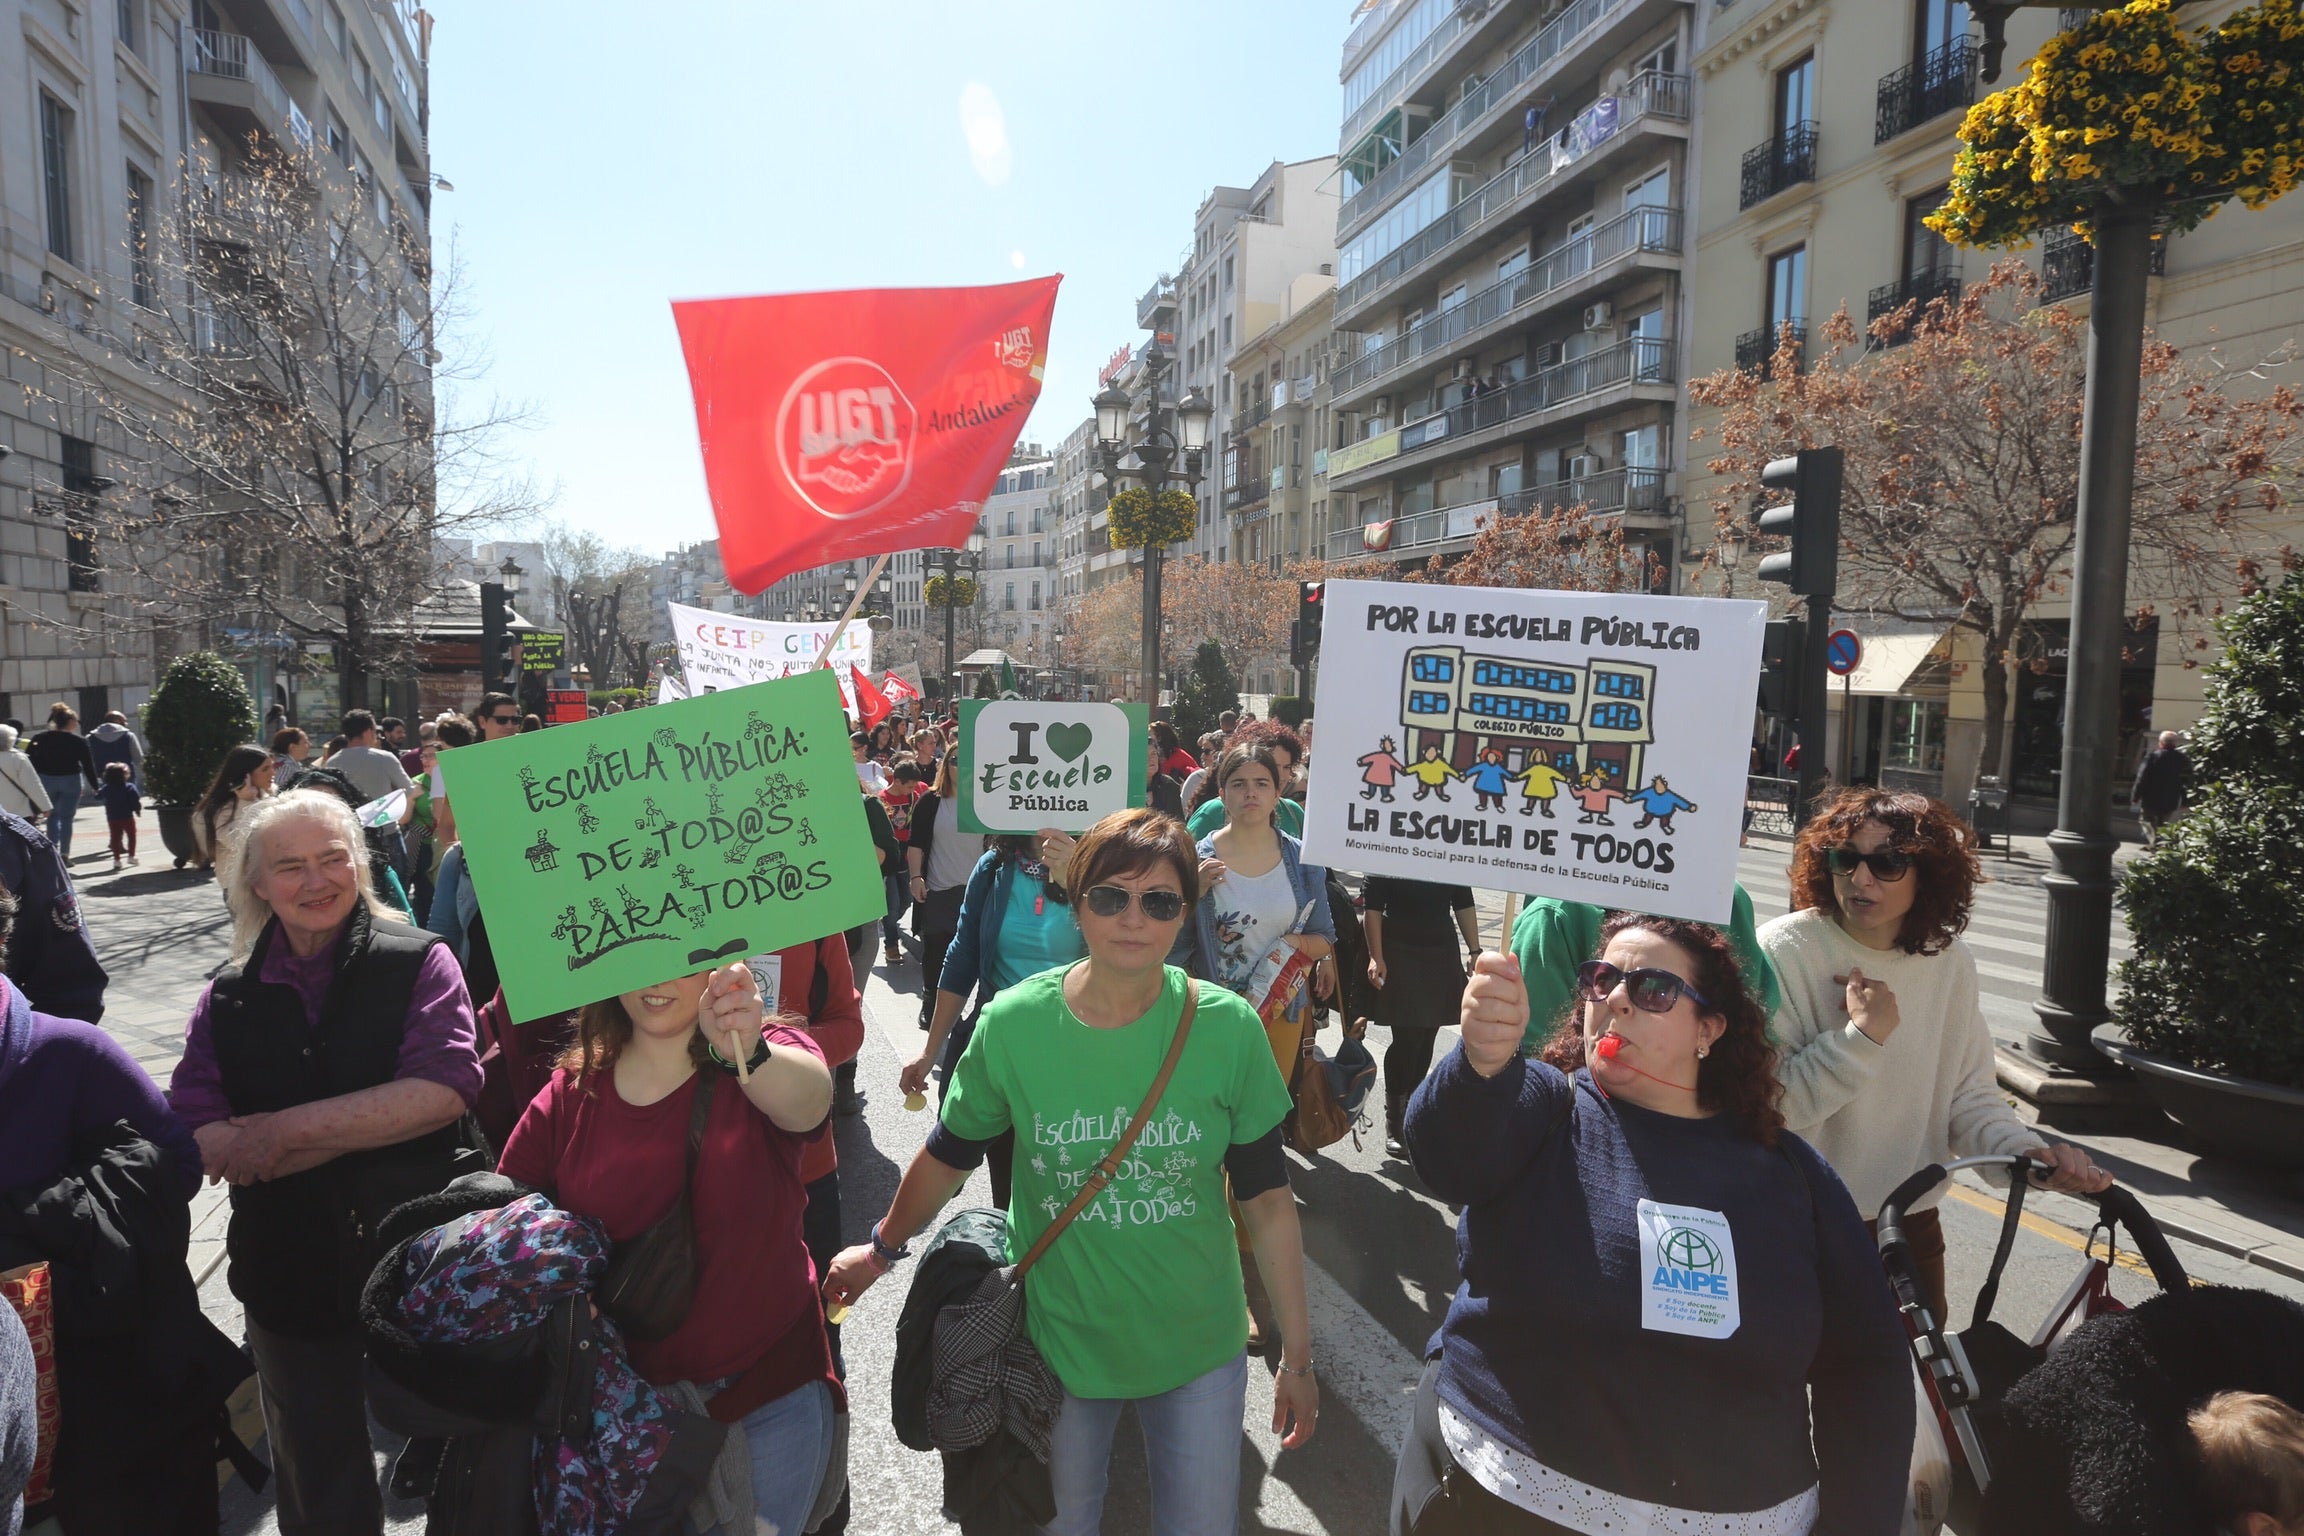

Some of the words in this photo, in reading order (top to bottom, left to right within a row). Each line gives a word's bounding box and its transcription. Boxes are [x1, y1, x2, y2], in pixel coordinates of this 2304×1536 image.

[1002, 326, 1031, 353] UGT
[800, 386, 897, 452] UGT
[697, 624, 764, 650] CEIP
[784, 631, 862, 654] GENIL
[1367, 604, 1418, 634] POR
[1427, 611, 1456, 634] LA
[1465, 613, 1572, 642] ESCUELA
[1580, 615, 1700, 650] PÚBLICA
[697, 663, 736, 677] INFANTIL
[701, 648, 741, 667] JUNTA
[749, 658, 774, 671] NOS
[1008, 722, 1039, 764] I
[1473, 719, 1517, 733] COLEGIO
[1519, 721, 1565, 738] PÚBLICO
[524, 742, 668, 812] ESCUELA
[674, 726, 809, 782] PÚBLICA:
[979, 755, 1112, 793] Escuela
[1009, 794, 1089, 812] Pública
[576, 838, 632, 881] DE
[651, 803, 794, 856] TOD@S
[1347, 803, 1379, 832] LA
[1390, 810, 1512, 848] ESCUELA
[1524, 829, 1558, 856] DE
[1571, 832, 1675, 874] TODOS
[1345, 838, 1409, 855] Movimiento
[1412, 846, 1446, 860] Social
[1449, 853, 1475, 863] para
[1478, 855, 1488, 865] la
[1491, 858, 1537, 872] defensa
[1541, 863, 1555, 874] de
[1558, 865, 1569, 876] la
[1572, 867, 1619, 884] Escuela
[1623, 874, 1670, 892] Pública
[568, 892, 687, 954] PARA
[692, 860, 832, 914] TOD@S
[1035, 1115, 1121, 1146] ESCUELA
[1056, 1168, 1088, 1190] DE
[1652, 1266, 1729, 1296] ANPE
[1652, 1286, 1682, 1294] SINDICATO
[1684, 1290, 1729, 1301] INDEPENDIENTE
[1679, 1306, 1688, 1314] de
[1687, 1300, 1717, 1310] docente
[1697, 1315, 1719, 1325] ANPE
